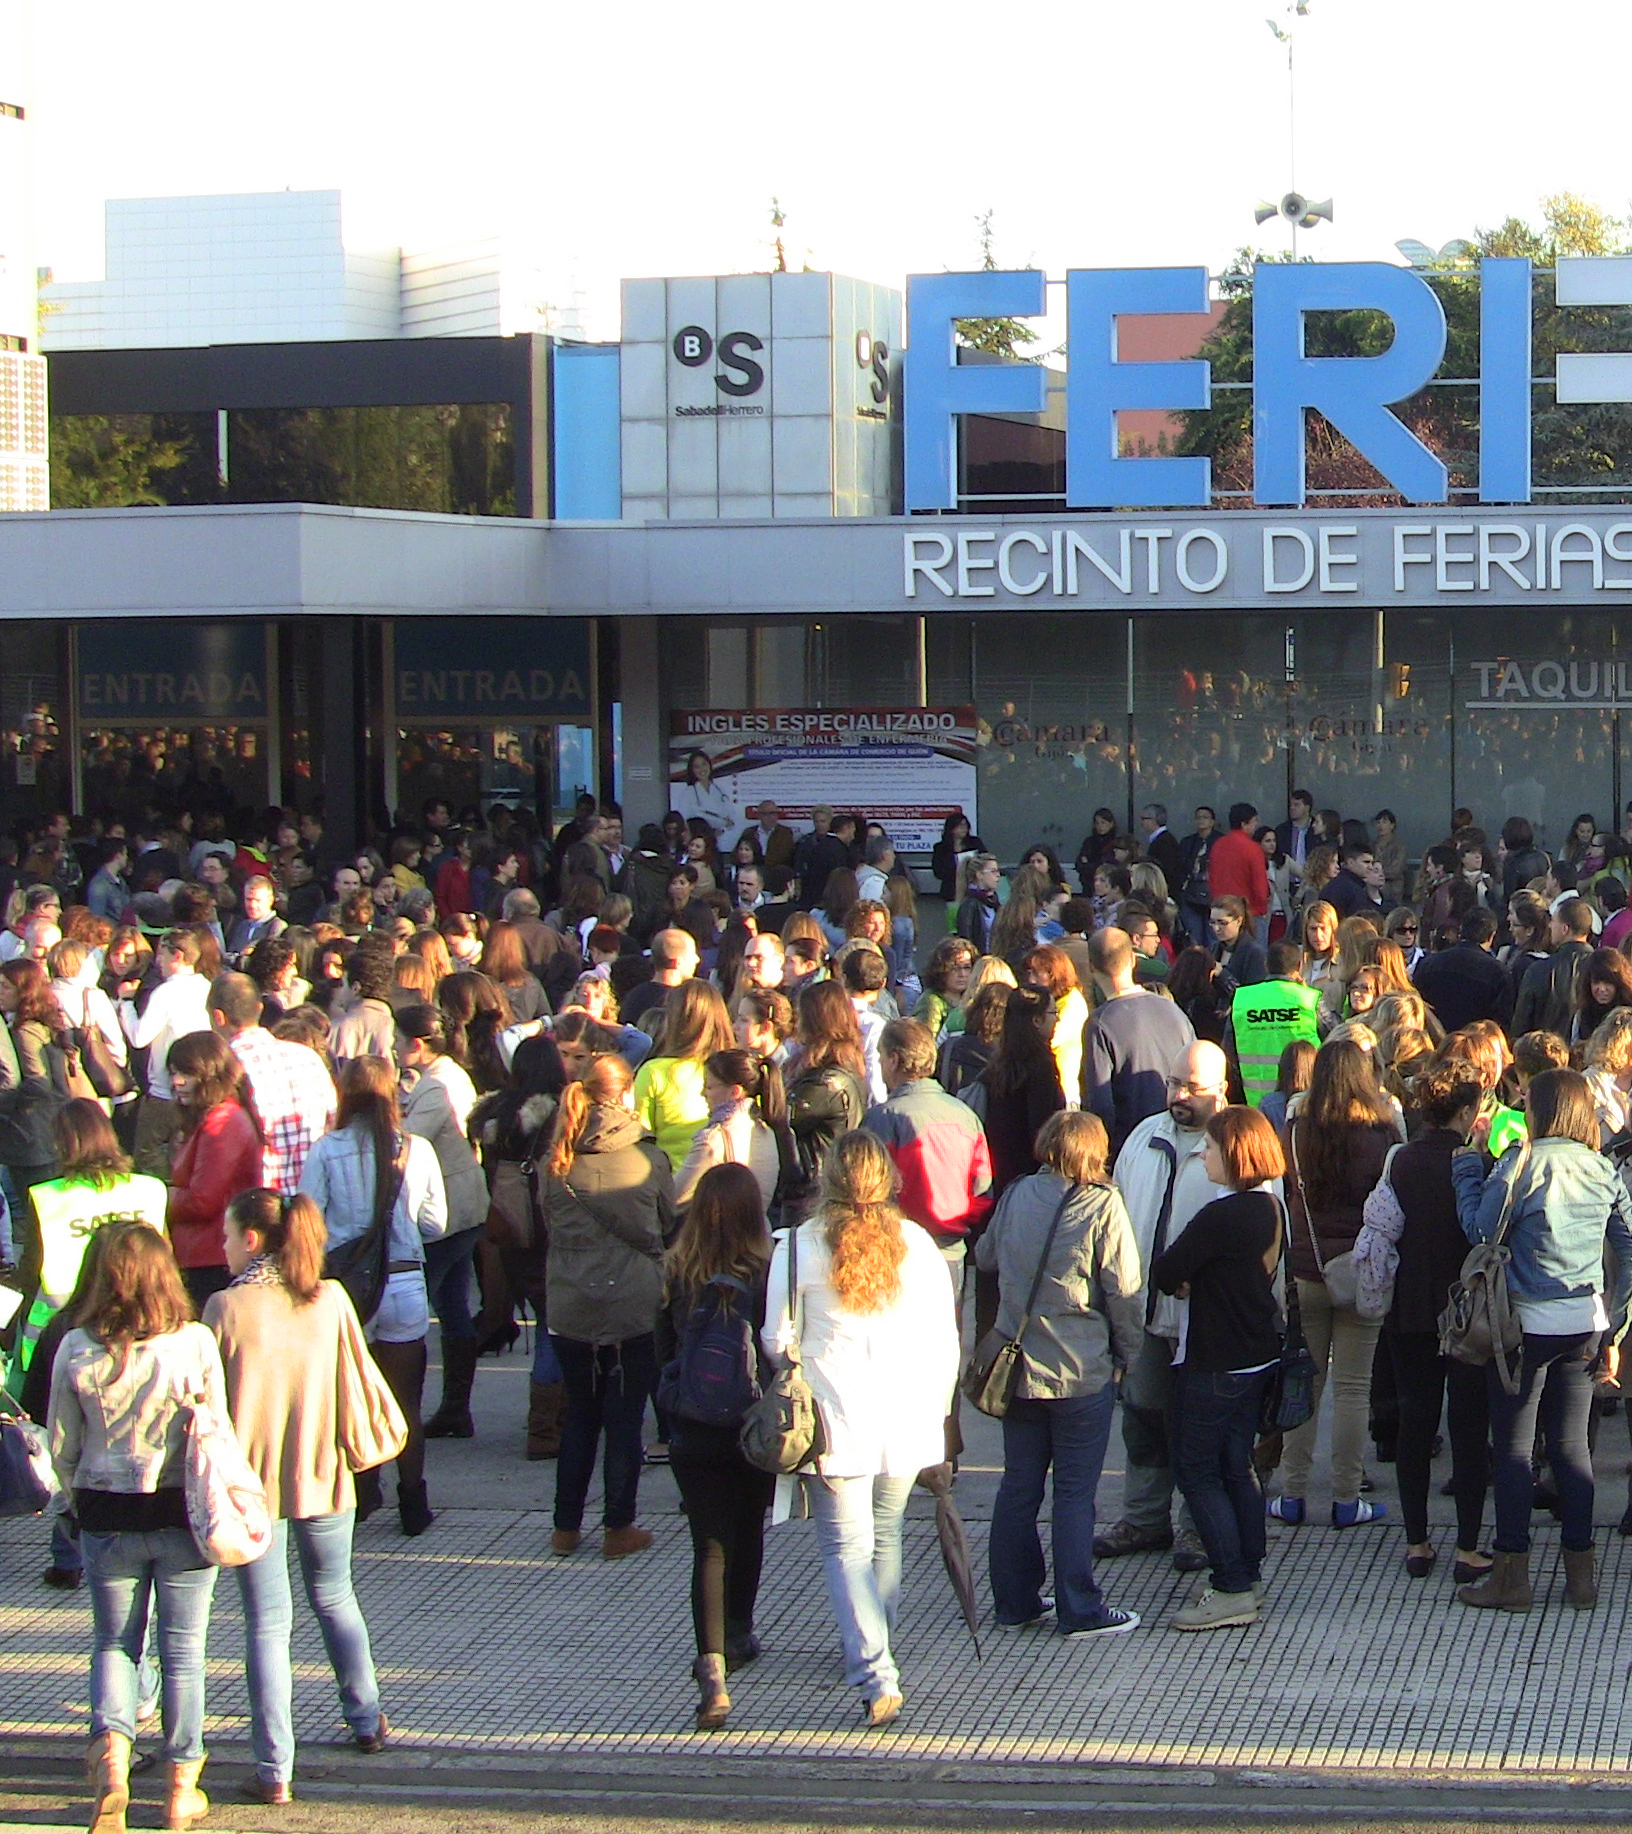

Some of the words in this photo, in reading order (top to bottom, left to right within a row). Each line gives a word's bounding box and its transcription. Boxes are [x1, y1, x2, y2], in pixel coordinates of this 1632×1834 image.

[904, 526, 1229, 599] RECINTO
[1263, 526, 1359, 594] DE
[82, 671, 263, 703] ENTRADA
[401, 669, 585, 699] ENTRADA
[776, 713, 955, 731] ESPECIALIZADO
[1246, 1008, 1301, 1023] SATSE
